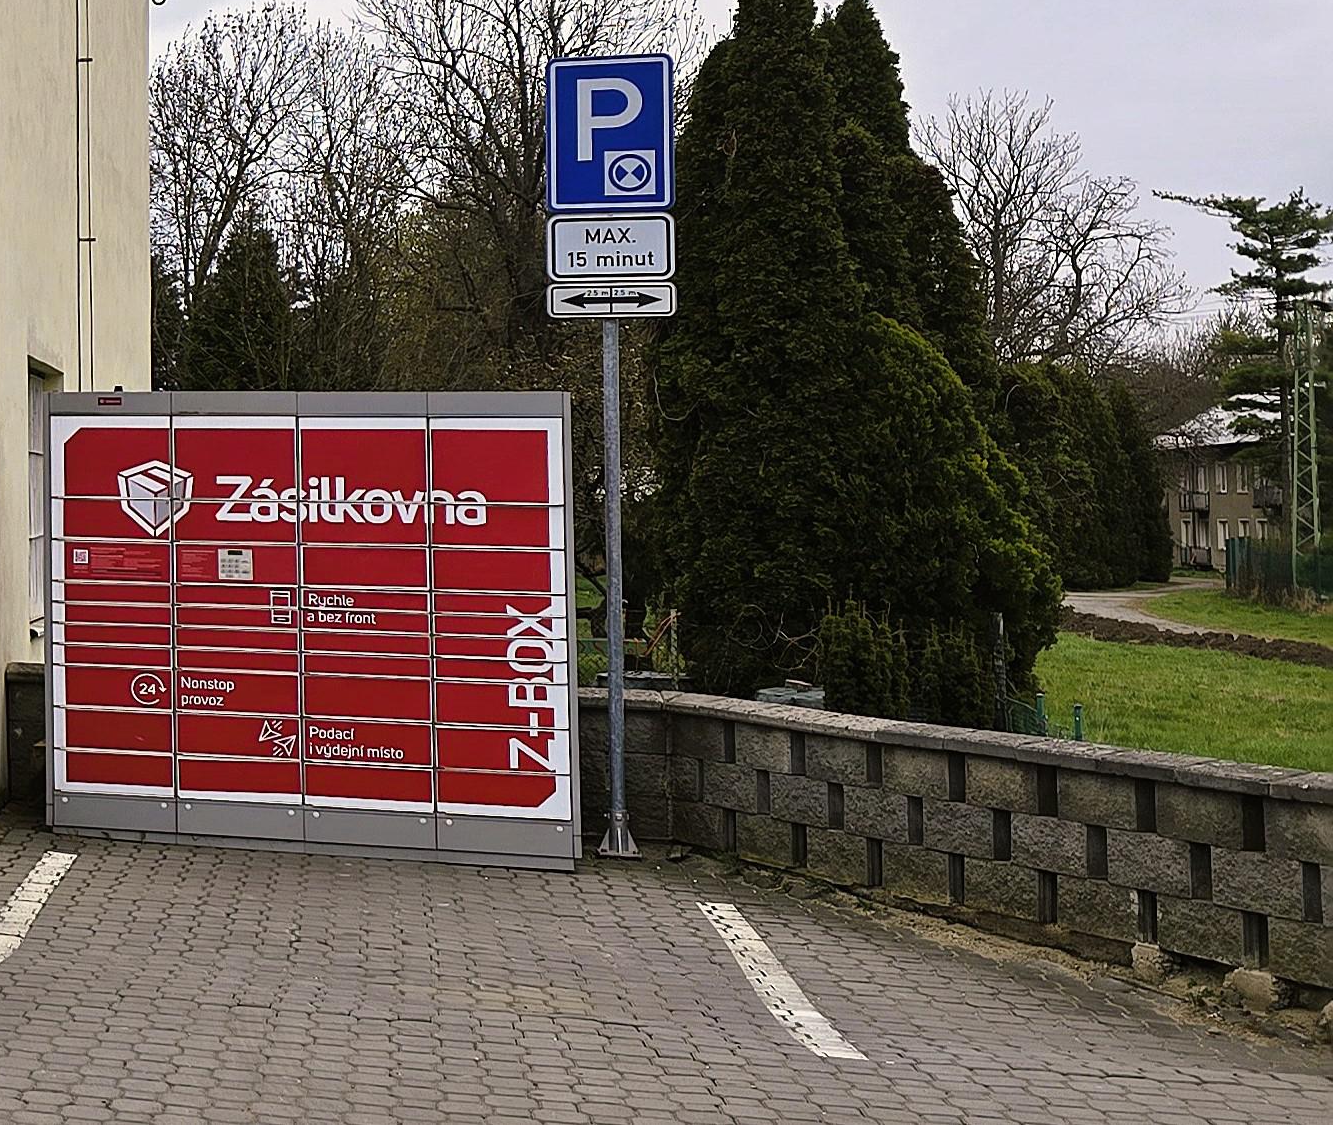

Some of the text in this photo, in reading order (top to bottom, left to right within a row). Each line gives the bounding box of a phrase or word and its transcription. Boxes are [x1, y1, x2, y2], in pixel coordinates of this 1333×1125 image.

[576, 77, 643, 162] P
[585, 227, 637, 244] MAX.
[567, 250, 655, 268] 15 minut
[214, 475, 487, 526] Zásilkovna
[308, 592, 355, 607] Rychle
[306, 611, 377, 625] a bez front
[138, 682, 156, 695] 24
[180, 675, 235, 693] Nonstop
[506, 603, 556, 773] Z-BOX
[181, 694, 225, 707] provoz
[308, 725, 355, 740] Podací
[309, 742, 404, 760] i výdejní místo
